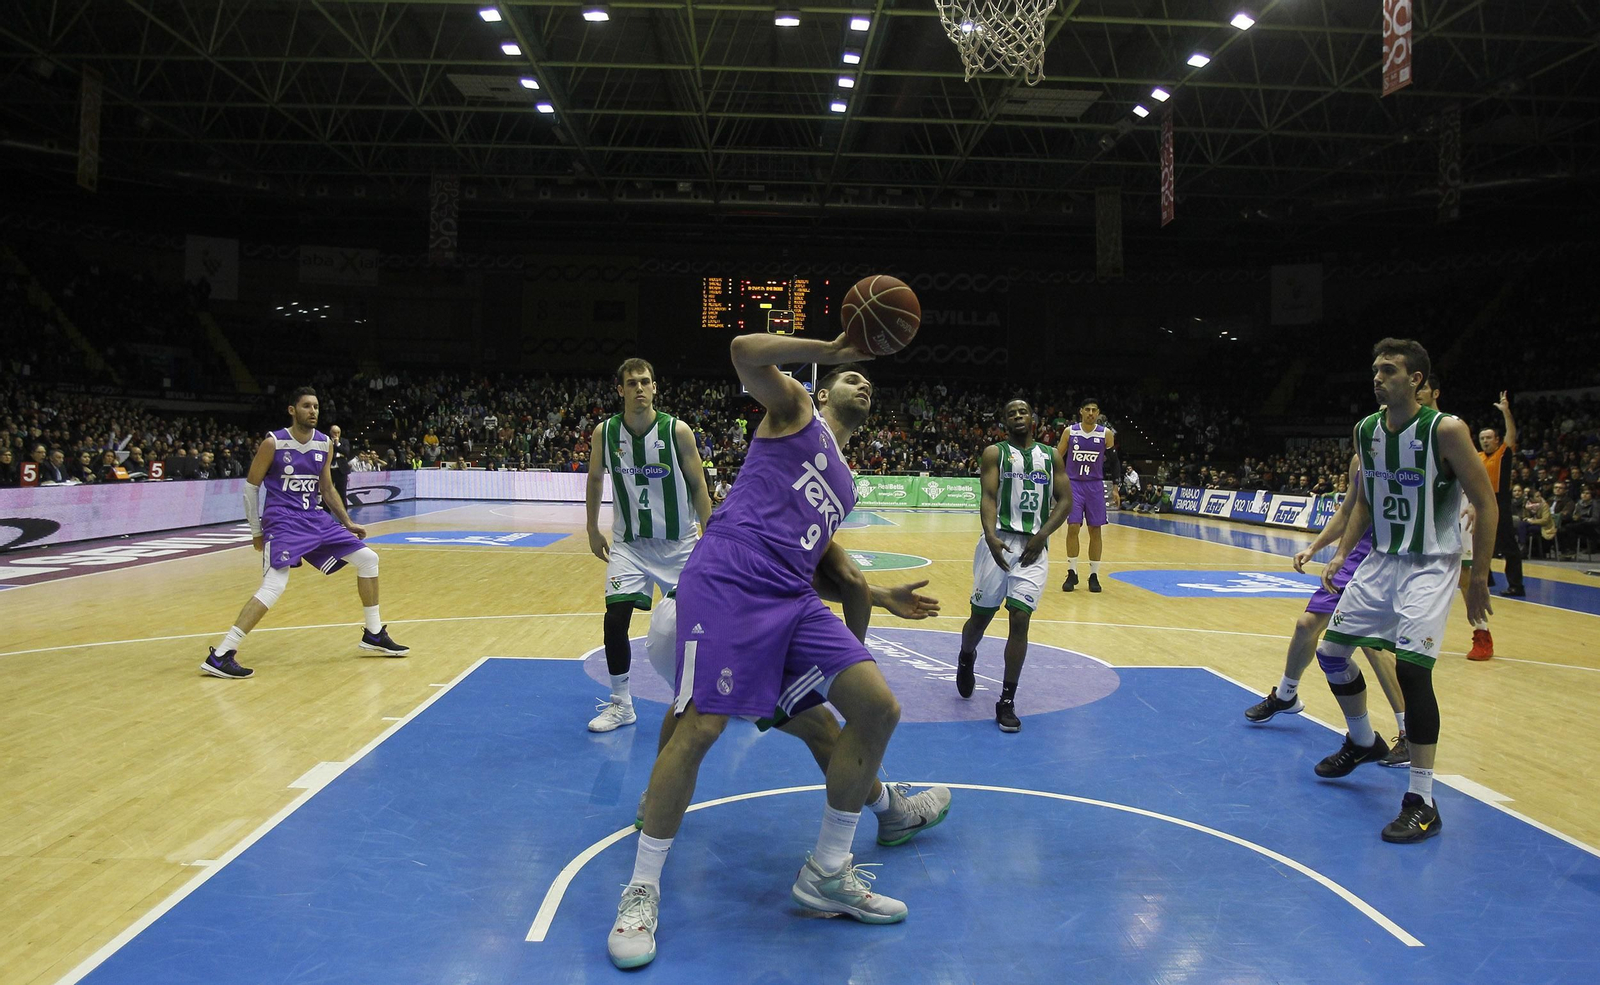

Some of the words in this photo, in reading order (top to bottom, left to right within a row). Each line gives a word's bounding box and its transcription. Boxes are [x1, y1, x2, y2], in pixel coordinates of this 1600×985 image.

[922, 310, 1000, 326] EVILLA
[23, 464, 37, 482] 5
[151, 462, 163, 478] 5
[645, 466, 663, 475] plus
[1032, 472, 1047, 481] plus
[1079, 464, 1090, 476] 14
[1399, 472, 1420, 481] plus
[302, 493, 310, 510] 5
[639, 488, 650, 508] 4
[1020, 491, 1039, 511] 23
[1180, 487, 1200, 500] TRABAJO
[1175, 499, 1199, 512] TEMPORAL
[1234, 499, 1246, 512] 902
[1383, 496, 1411, 521] 20
[800, 524, 821, 550] 9
